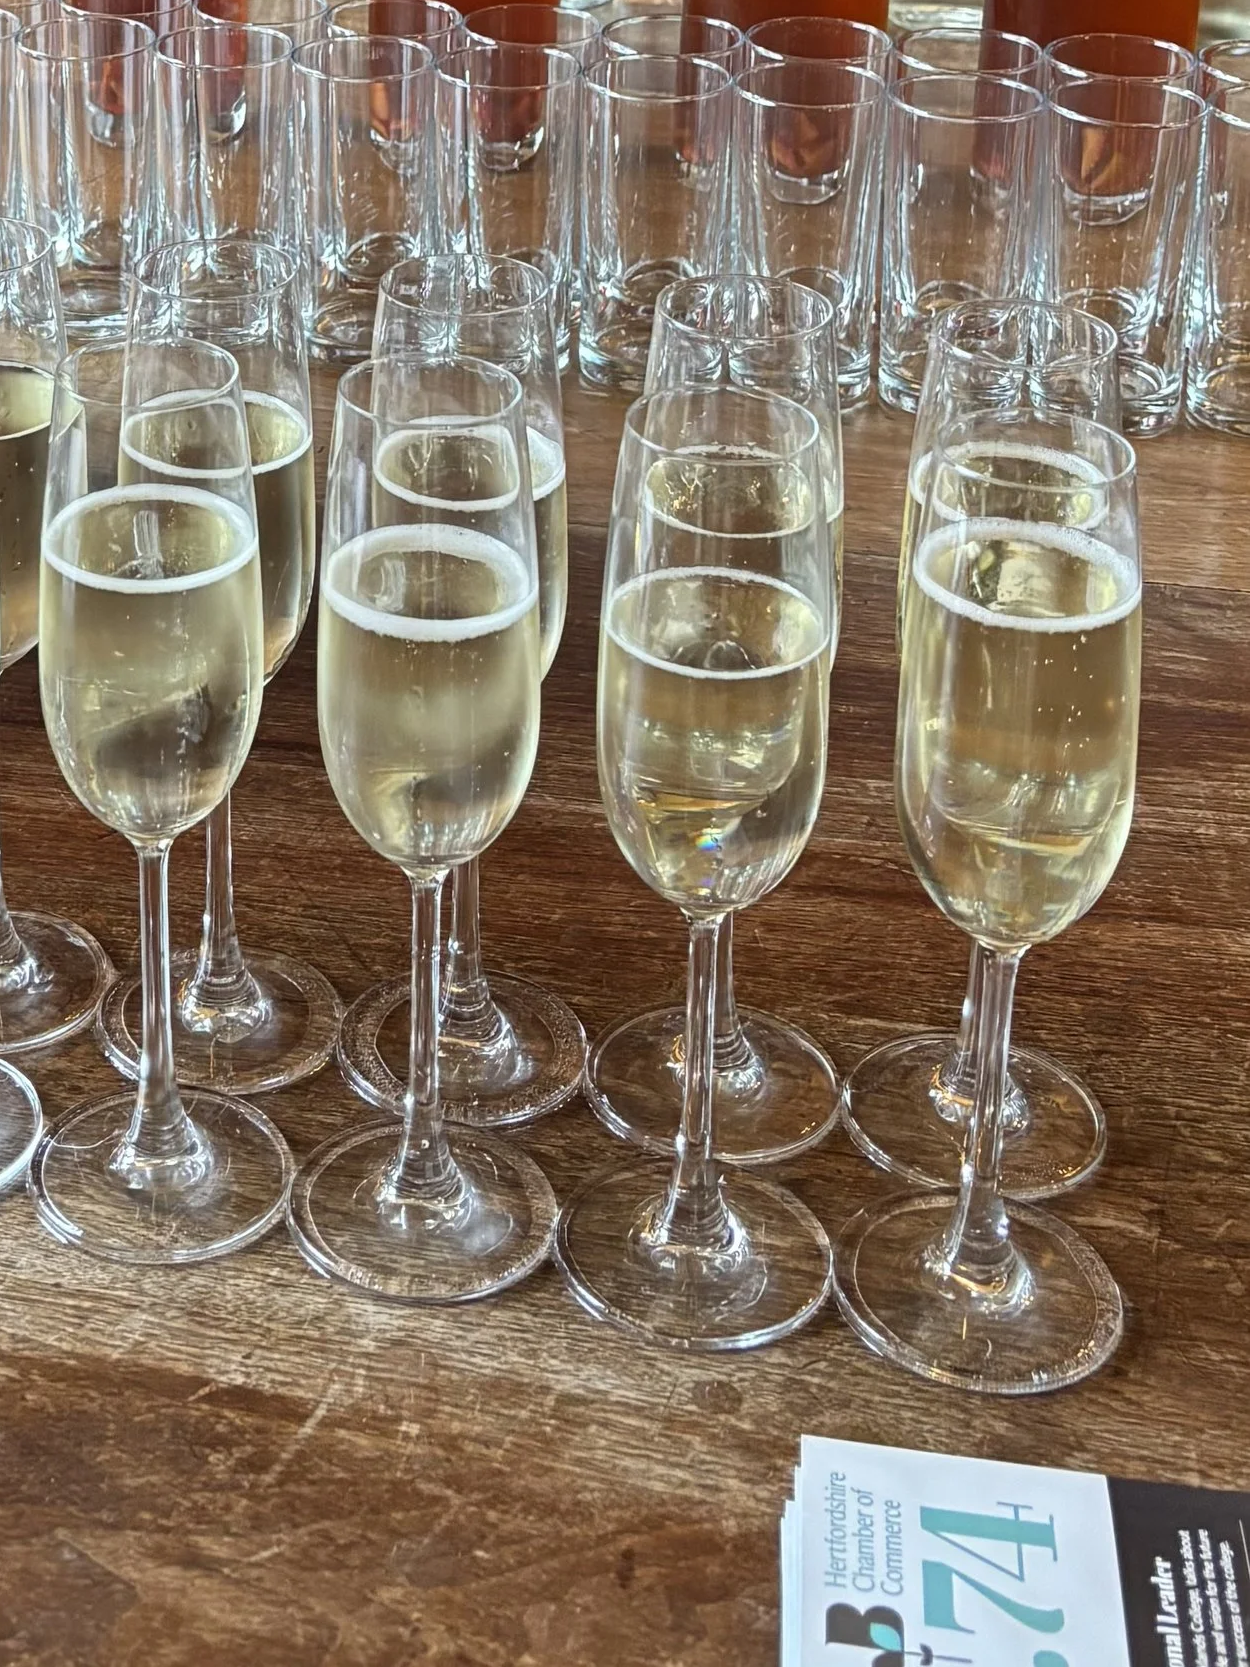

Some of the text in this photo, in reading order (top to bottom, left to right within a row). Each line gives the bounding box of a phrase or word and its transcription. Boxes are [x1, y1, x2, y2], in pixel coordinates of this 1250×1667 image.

[824, 1471, 846, 1588] Hertfordshire
[851, 1487, 875, 1592] Chamber of
[1177, 1529, 1194, 1560] about
[1198, 1529, 1213, 1560] future
[880, 1500, 904, 1596] Commerce
[1219, 1539, 1236, 1582] college.
[1182, 1560, 1198, 1586] talks
[1202, 1560, 1216, 1579] the
[1150, 1556, 1179, 1624] Leader
[1205, 1580, 1218, 1596] for
[1224, 1580, 1238, 1600] the
[1209, 1597, 1224, 1631] vision
[1226, 1599, 1241, 1614] of
[1211, 1630, 1228, 1654] and
[1231, 1615, 1248, 1658] success
